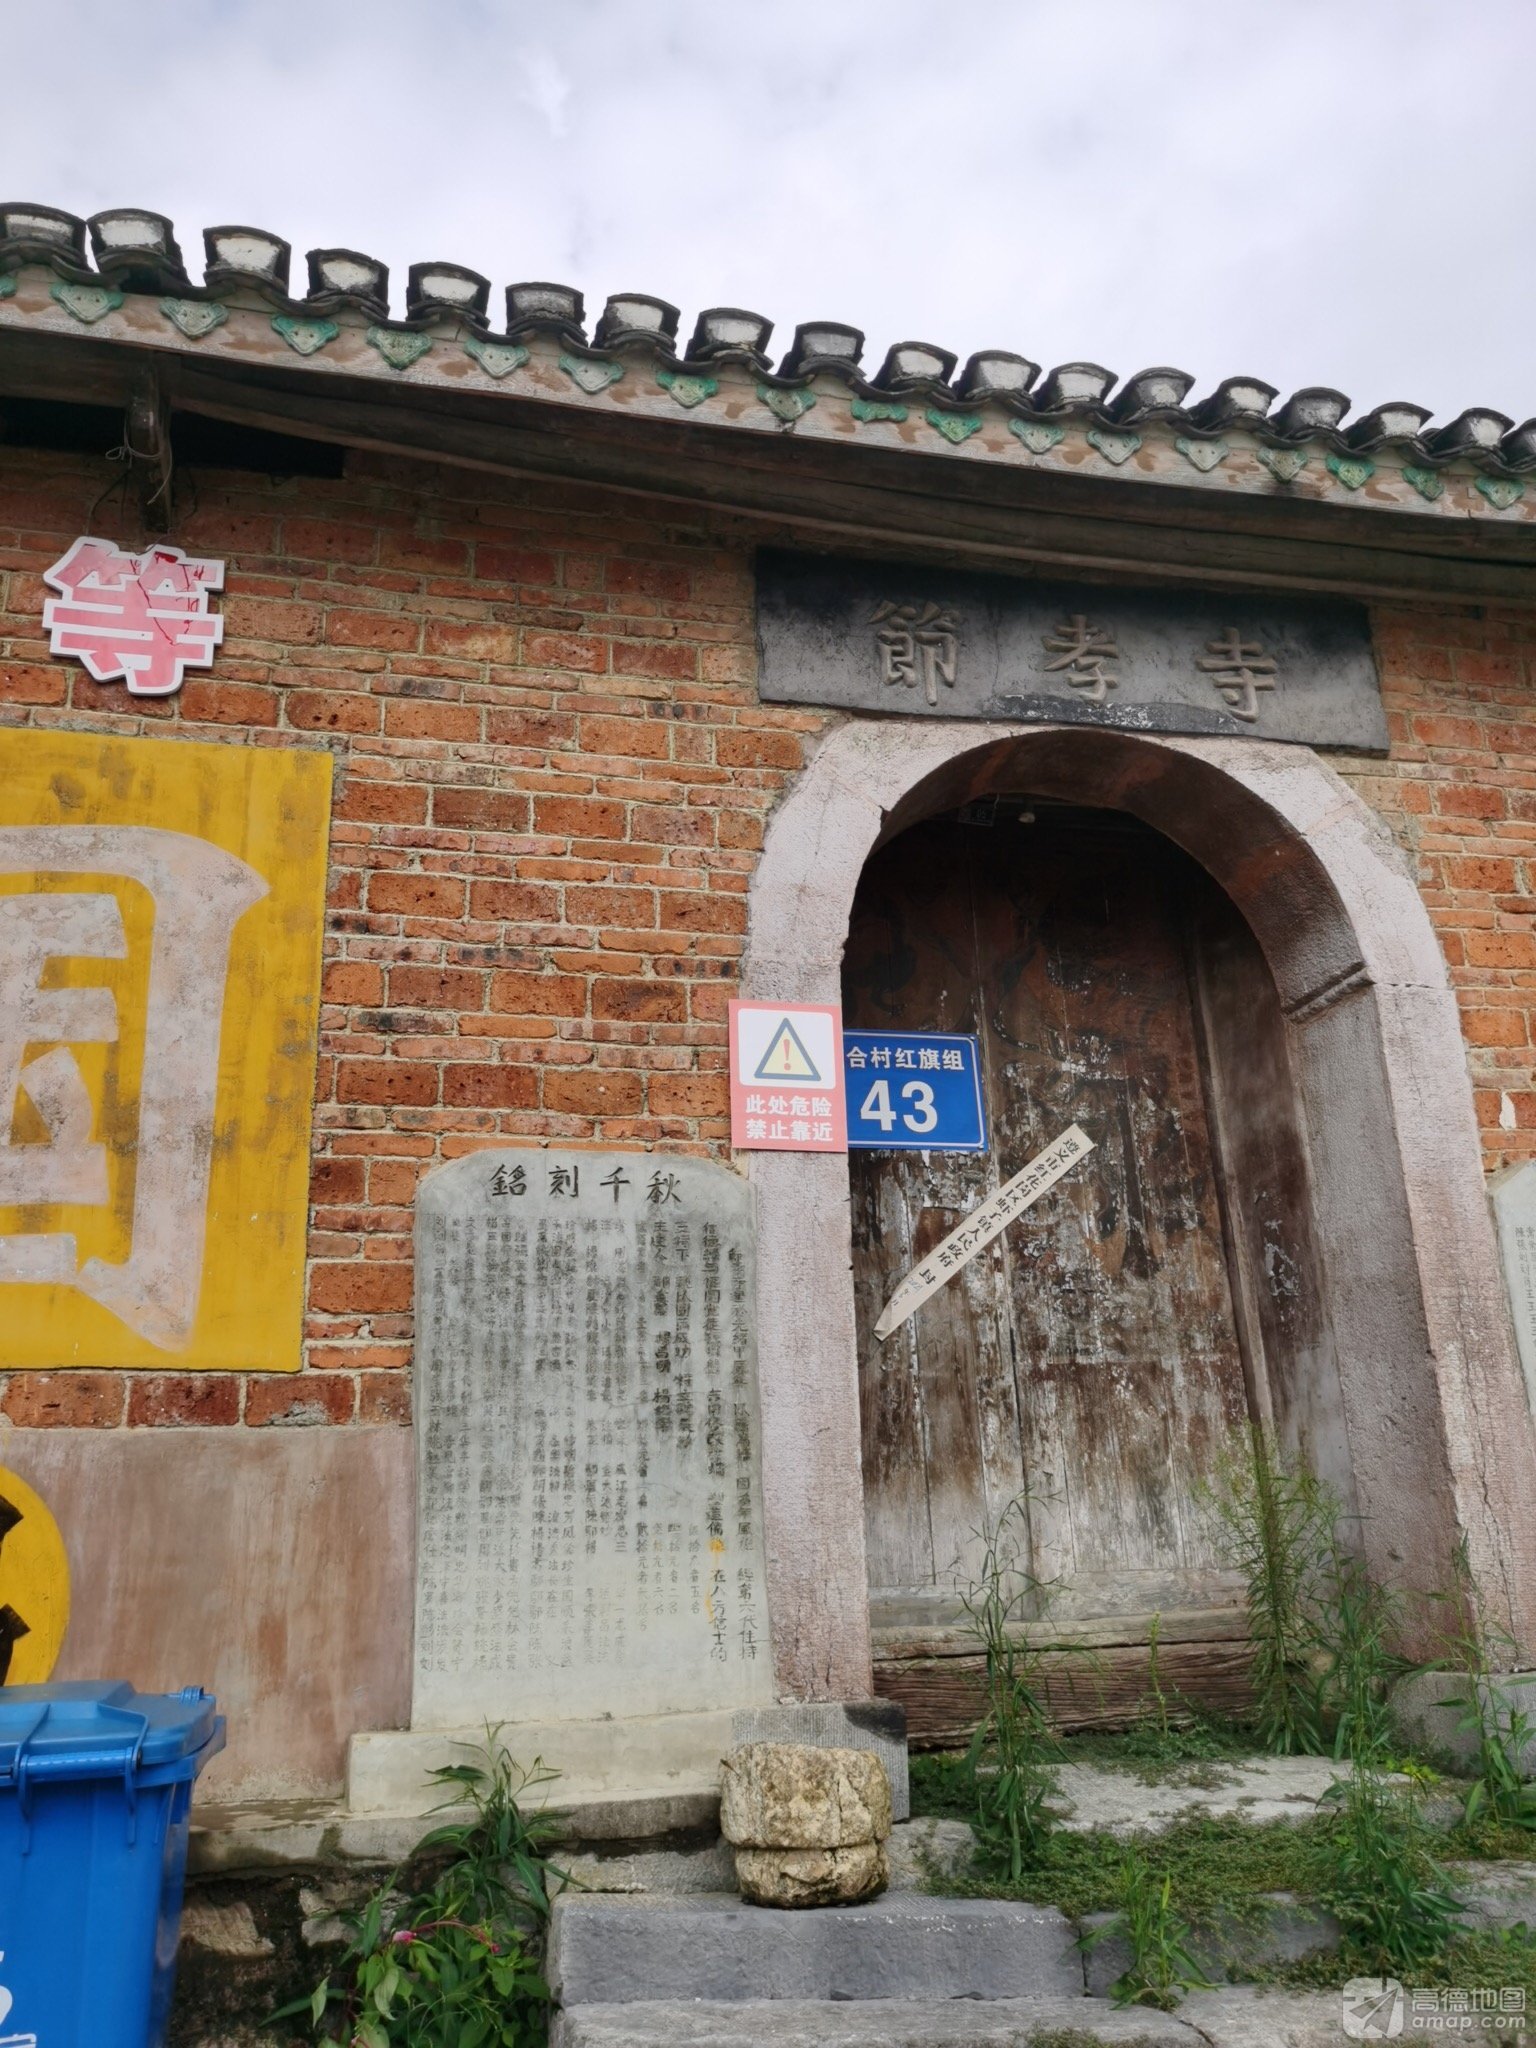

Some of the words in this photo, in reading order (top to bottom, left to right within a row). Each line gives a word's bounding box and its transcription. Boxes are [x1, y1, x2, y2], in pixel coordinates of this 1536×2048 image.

[868, 599, 1278, 724] 節孝寺
[846, 1045, 965, 1071] 合村红旗组
[745, 1094, 832, 1117] 此处危险
[860, 1079, 938, 1133] 43
[745, 1118, 834, 1142] 禁止靠近
